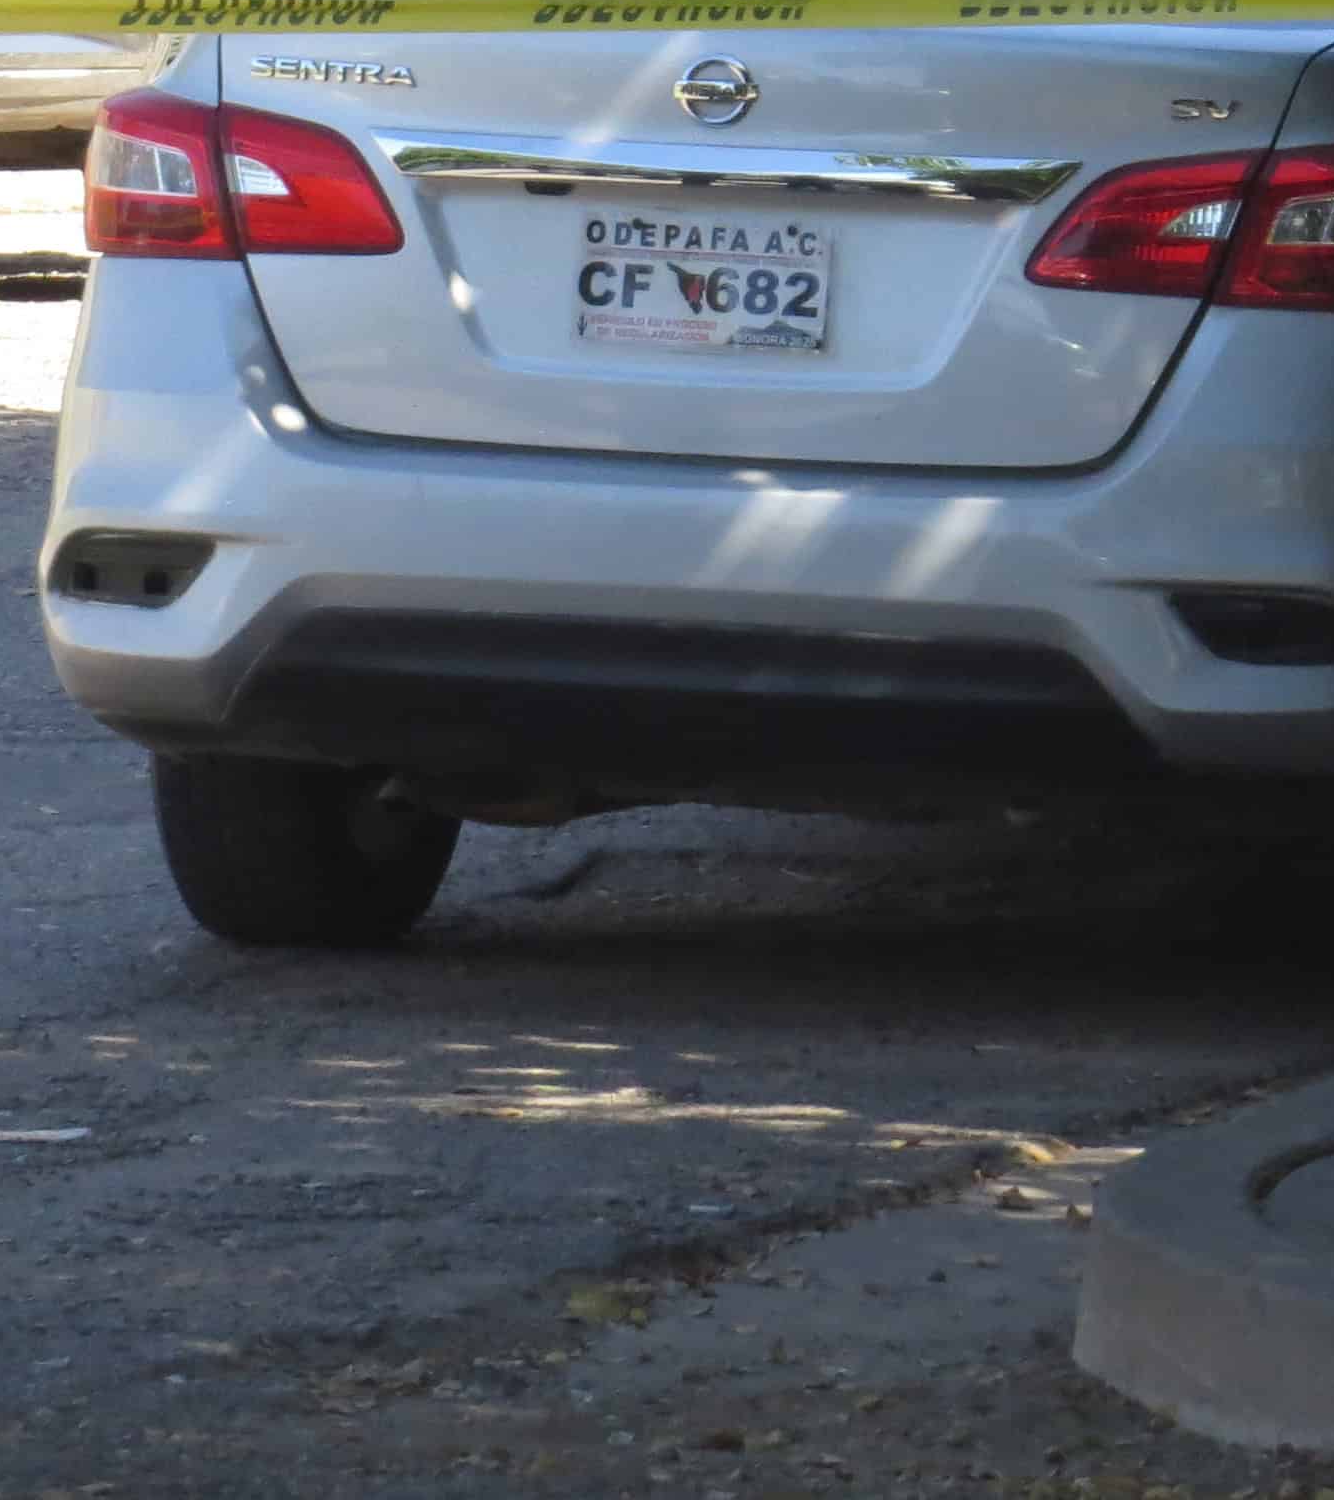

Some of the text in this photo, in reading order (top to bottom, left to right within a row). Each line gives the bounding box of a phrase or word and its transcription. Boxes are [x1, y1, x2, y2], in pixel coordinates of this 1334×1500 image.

[249, 53, 417, 88] SENTRA
[1170, 99, 1240, 120] SV
[585, 218, 750, 252] ODEPAFA
[578, 260, 821, 319] CF 682
